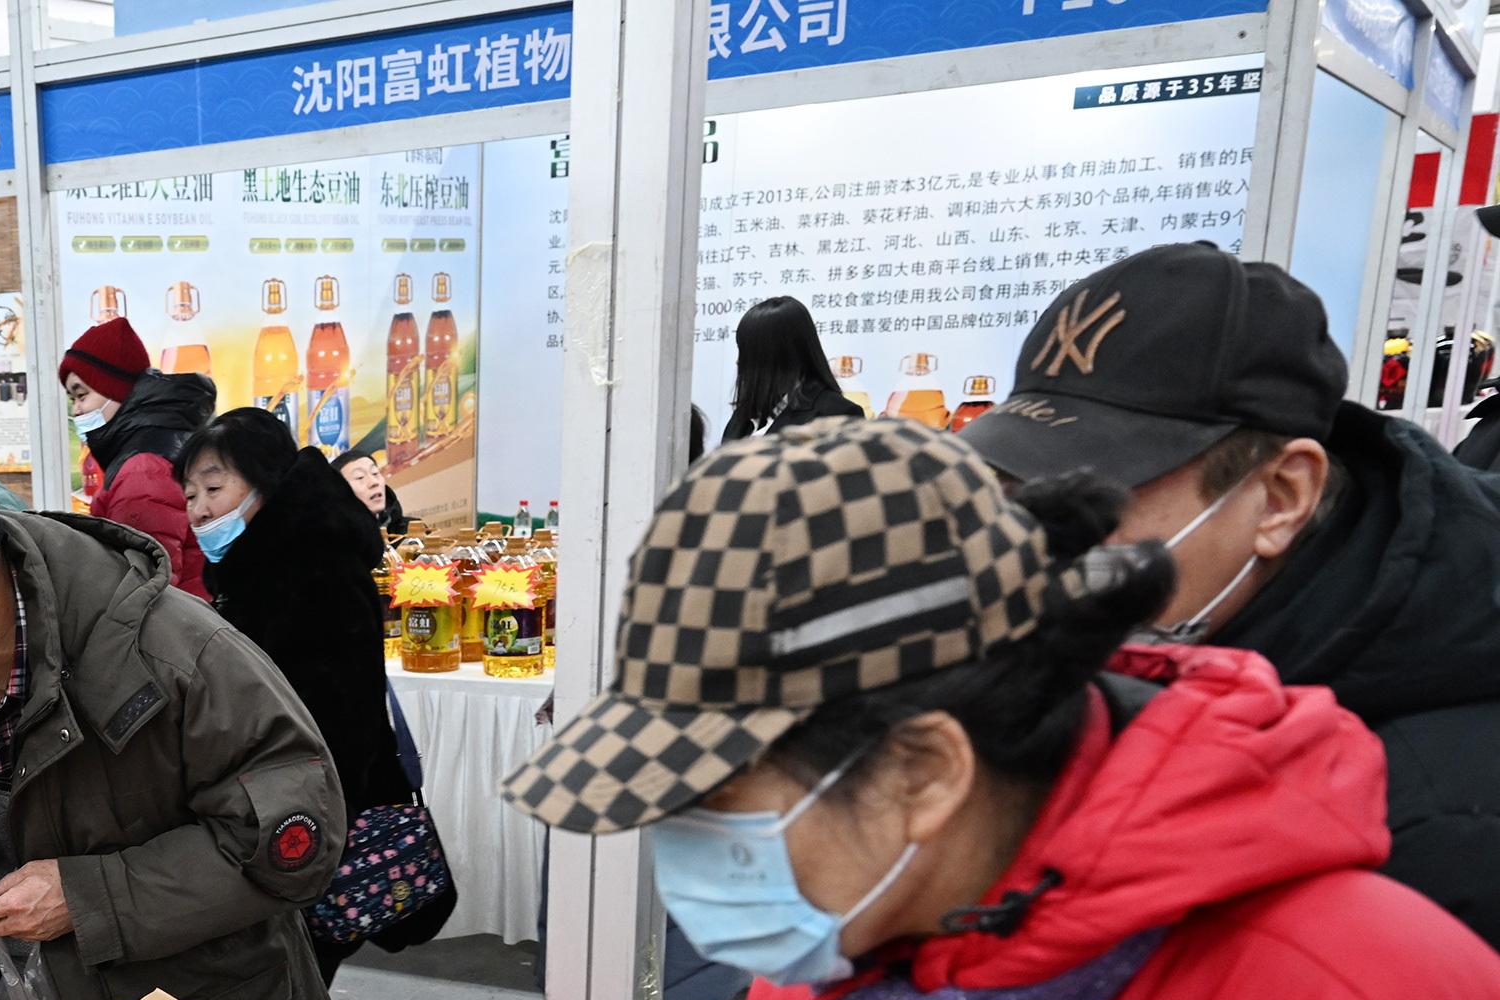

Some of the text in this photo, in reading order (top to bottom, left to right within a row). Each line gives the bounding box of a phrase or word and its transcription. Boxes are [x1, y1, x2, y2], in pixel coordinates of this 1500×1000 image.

[291, 26, 572, 117] 沈阳富虹植物
[1097, 71, 1262, 106] 品质源于35年坚
[243, 167, 361, 205] 黑土地生态豆油
[379, 171, 469, 211] 东北压榨豆油
[108, 212, 145, 225] VITAMIN
[147, 213, 153, 225] E
[155, 212, 197, 225] SOYBEAN
[698, 178, 1251, 239] 油、玉米油、菜籽油、葵花籽油、调和油六大系列30个品种,年销售收入
[815, 309, 1040, 337] 年我最喜爱的中国品牌位列第1
